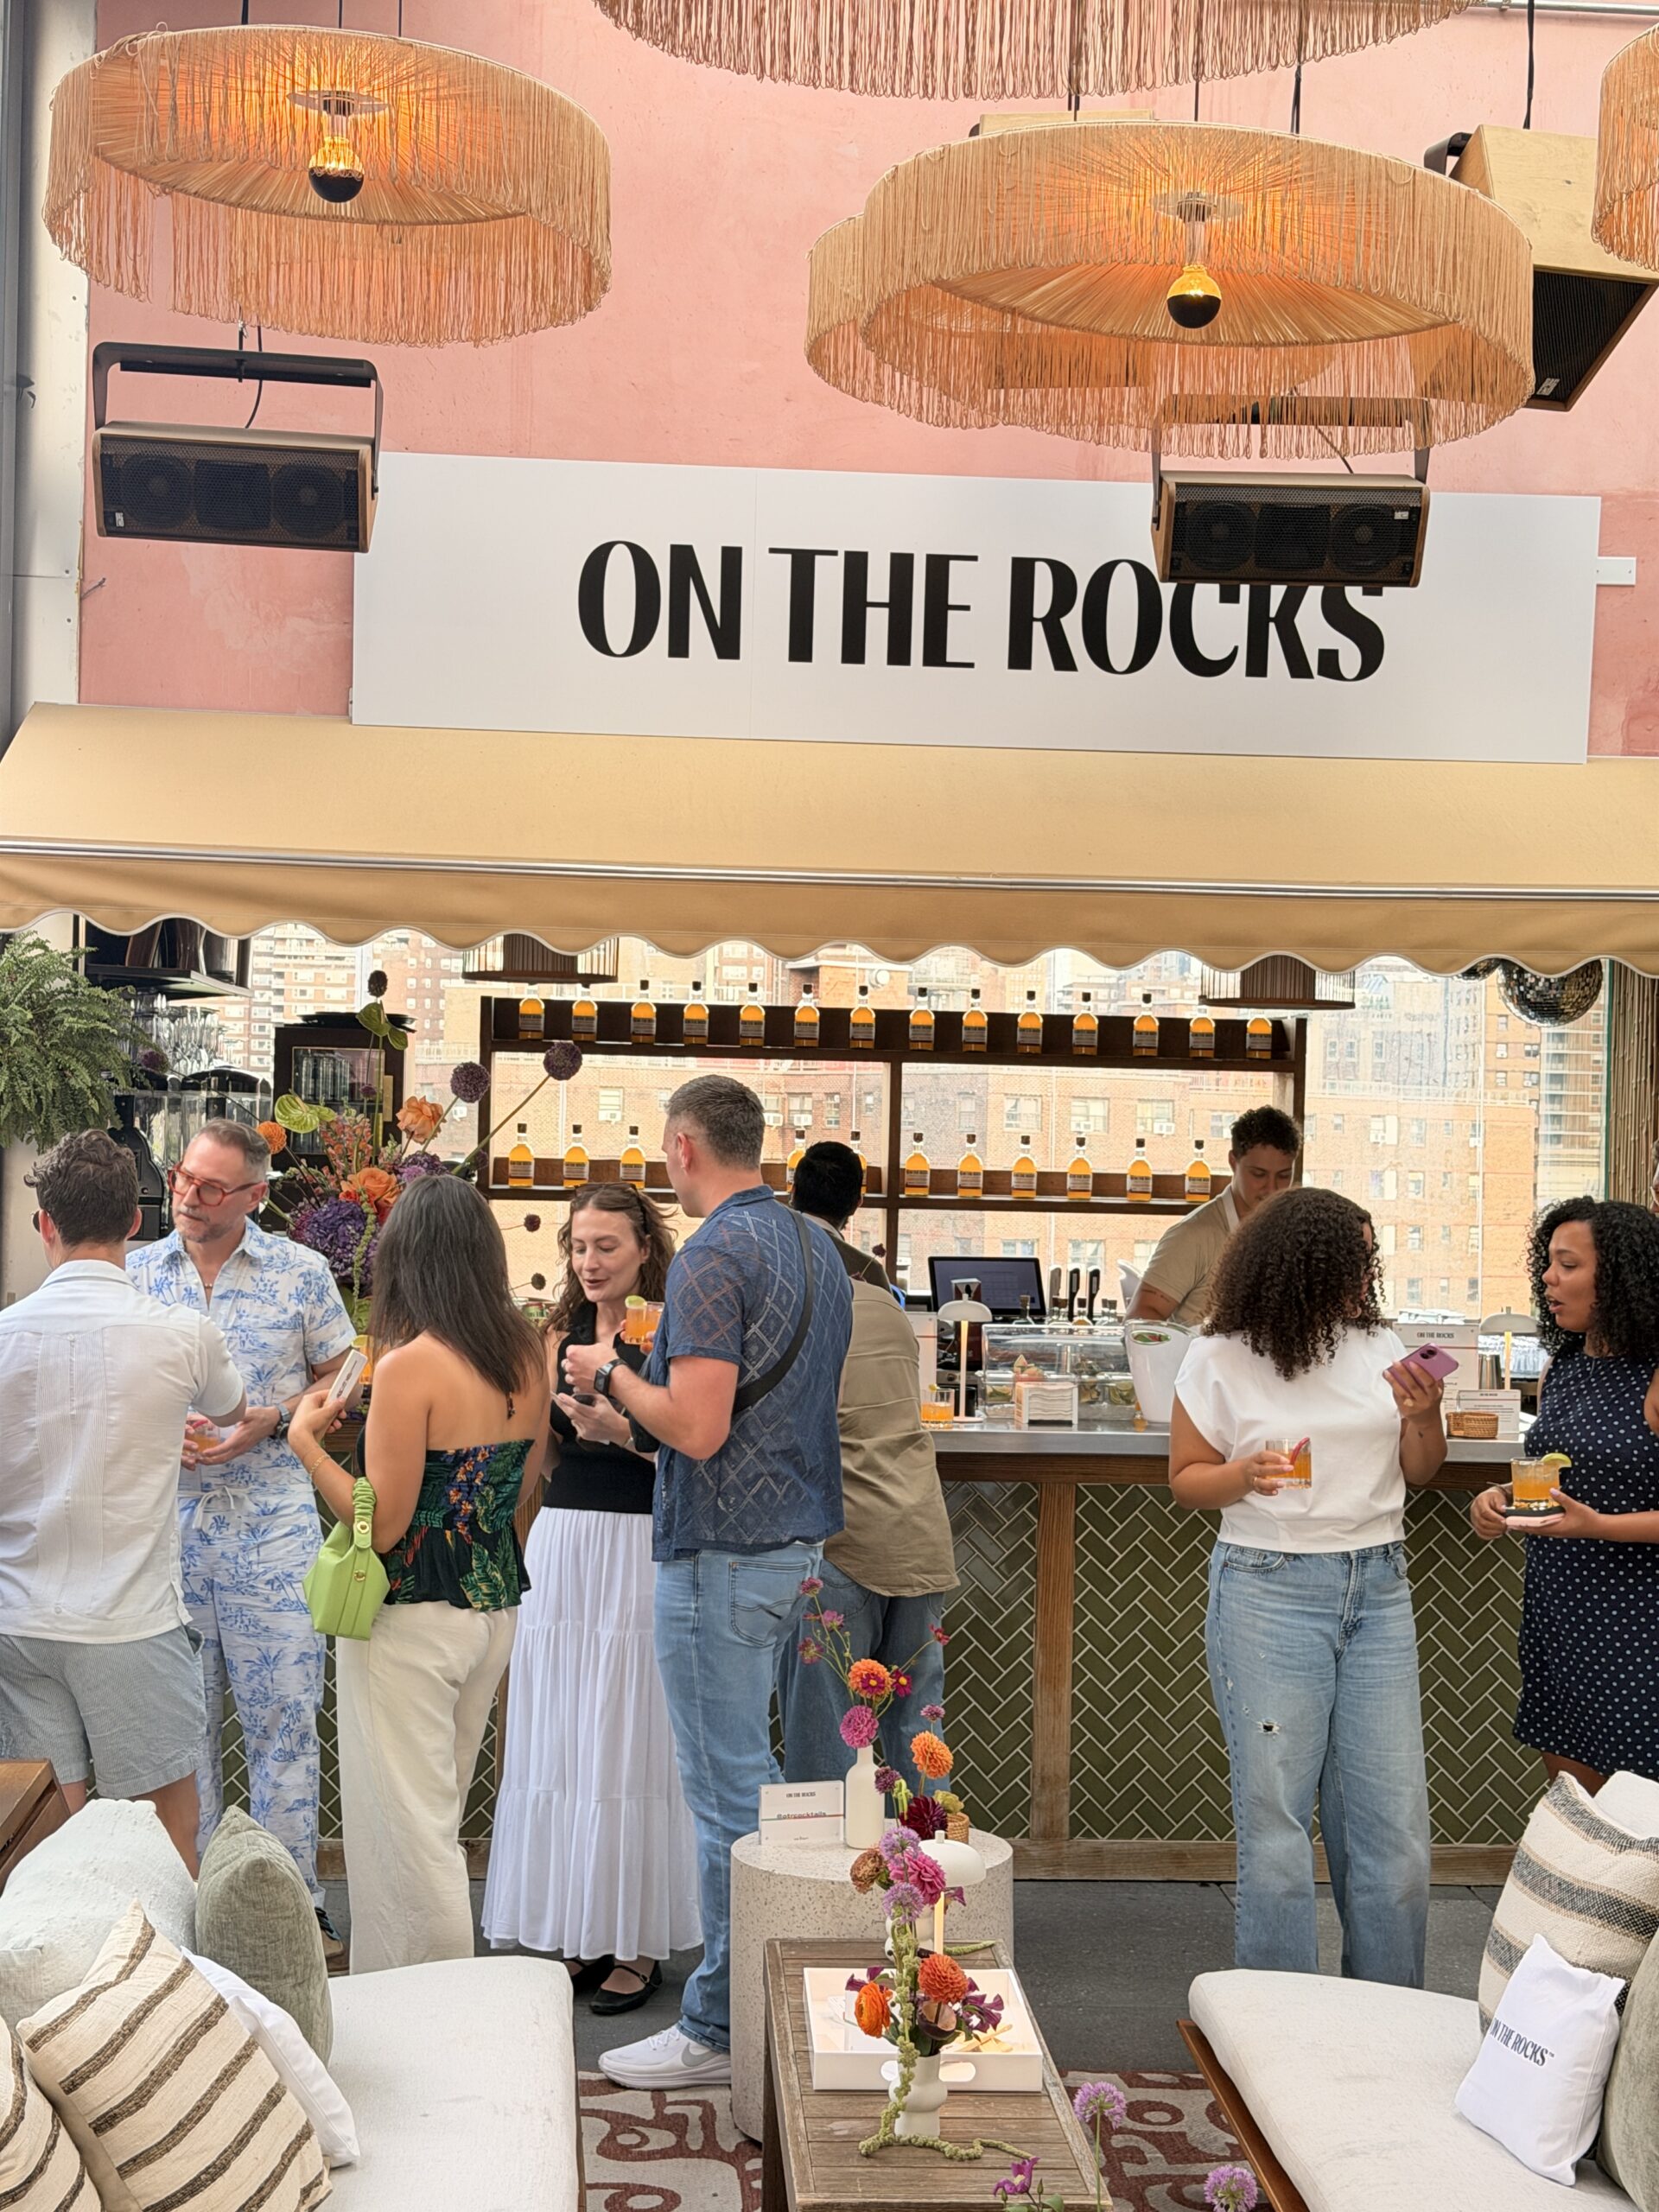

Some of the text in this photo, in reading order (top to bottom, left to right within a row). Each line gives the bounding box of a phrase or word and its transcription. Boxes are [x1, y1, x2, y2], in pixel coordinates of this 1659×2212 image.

[578, 540, 1385, 682] ON THE ROCKS
[1497, 2023, 1516, 2048] THE
